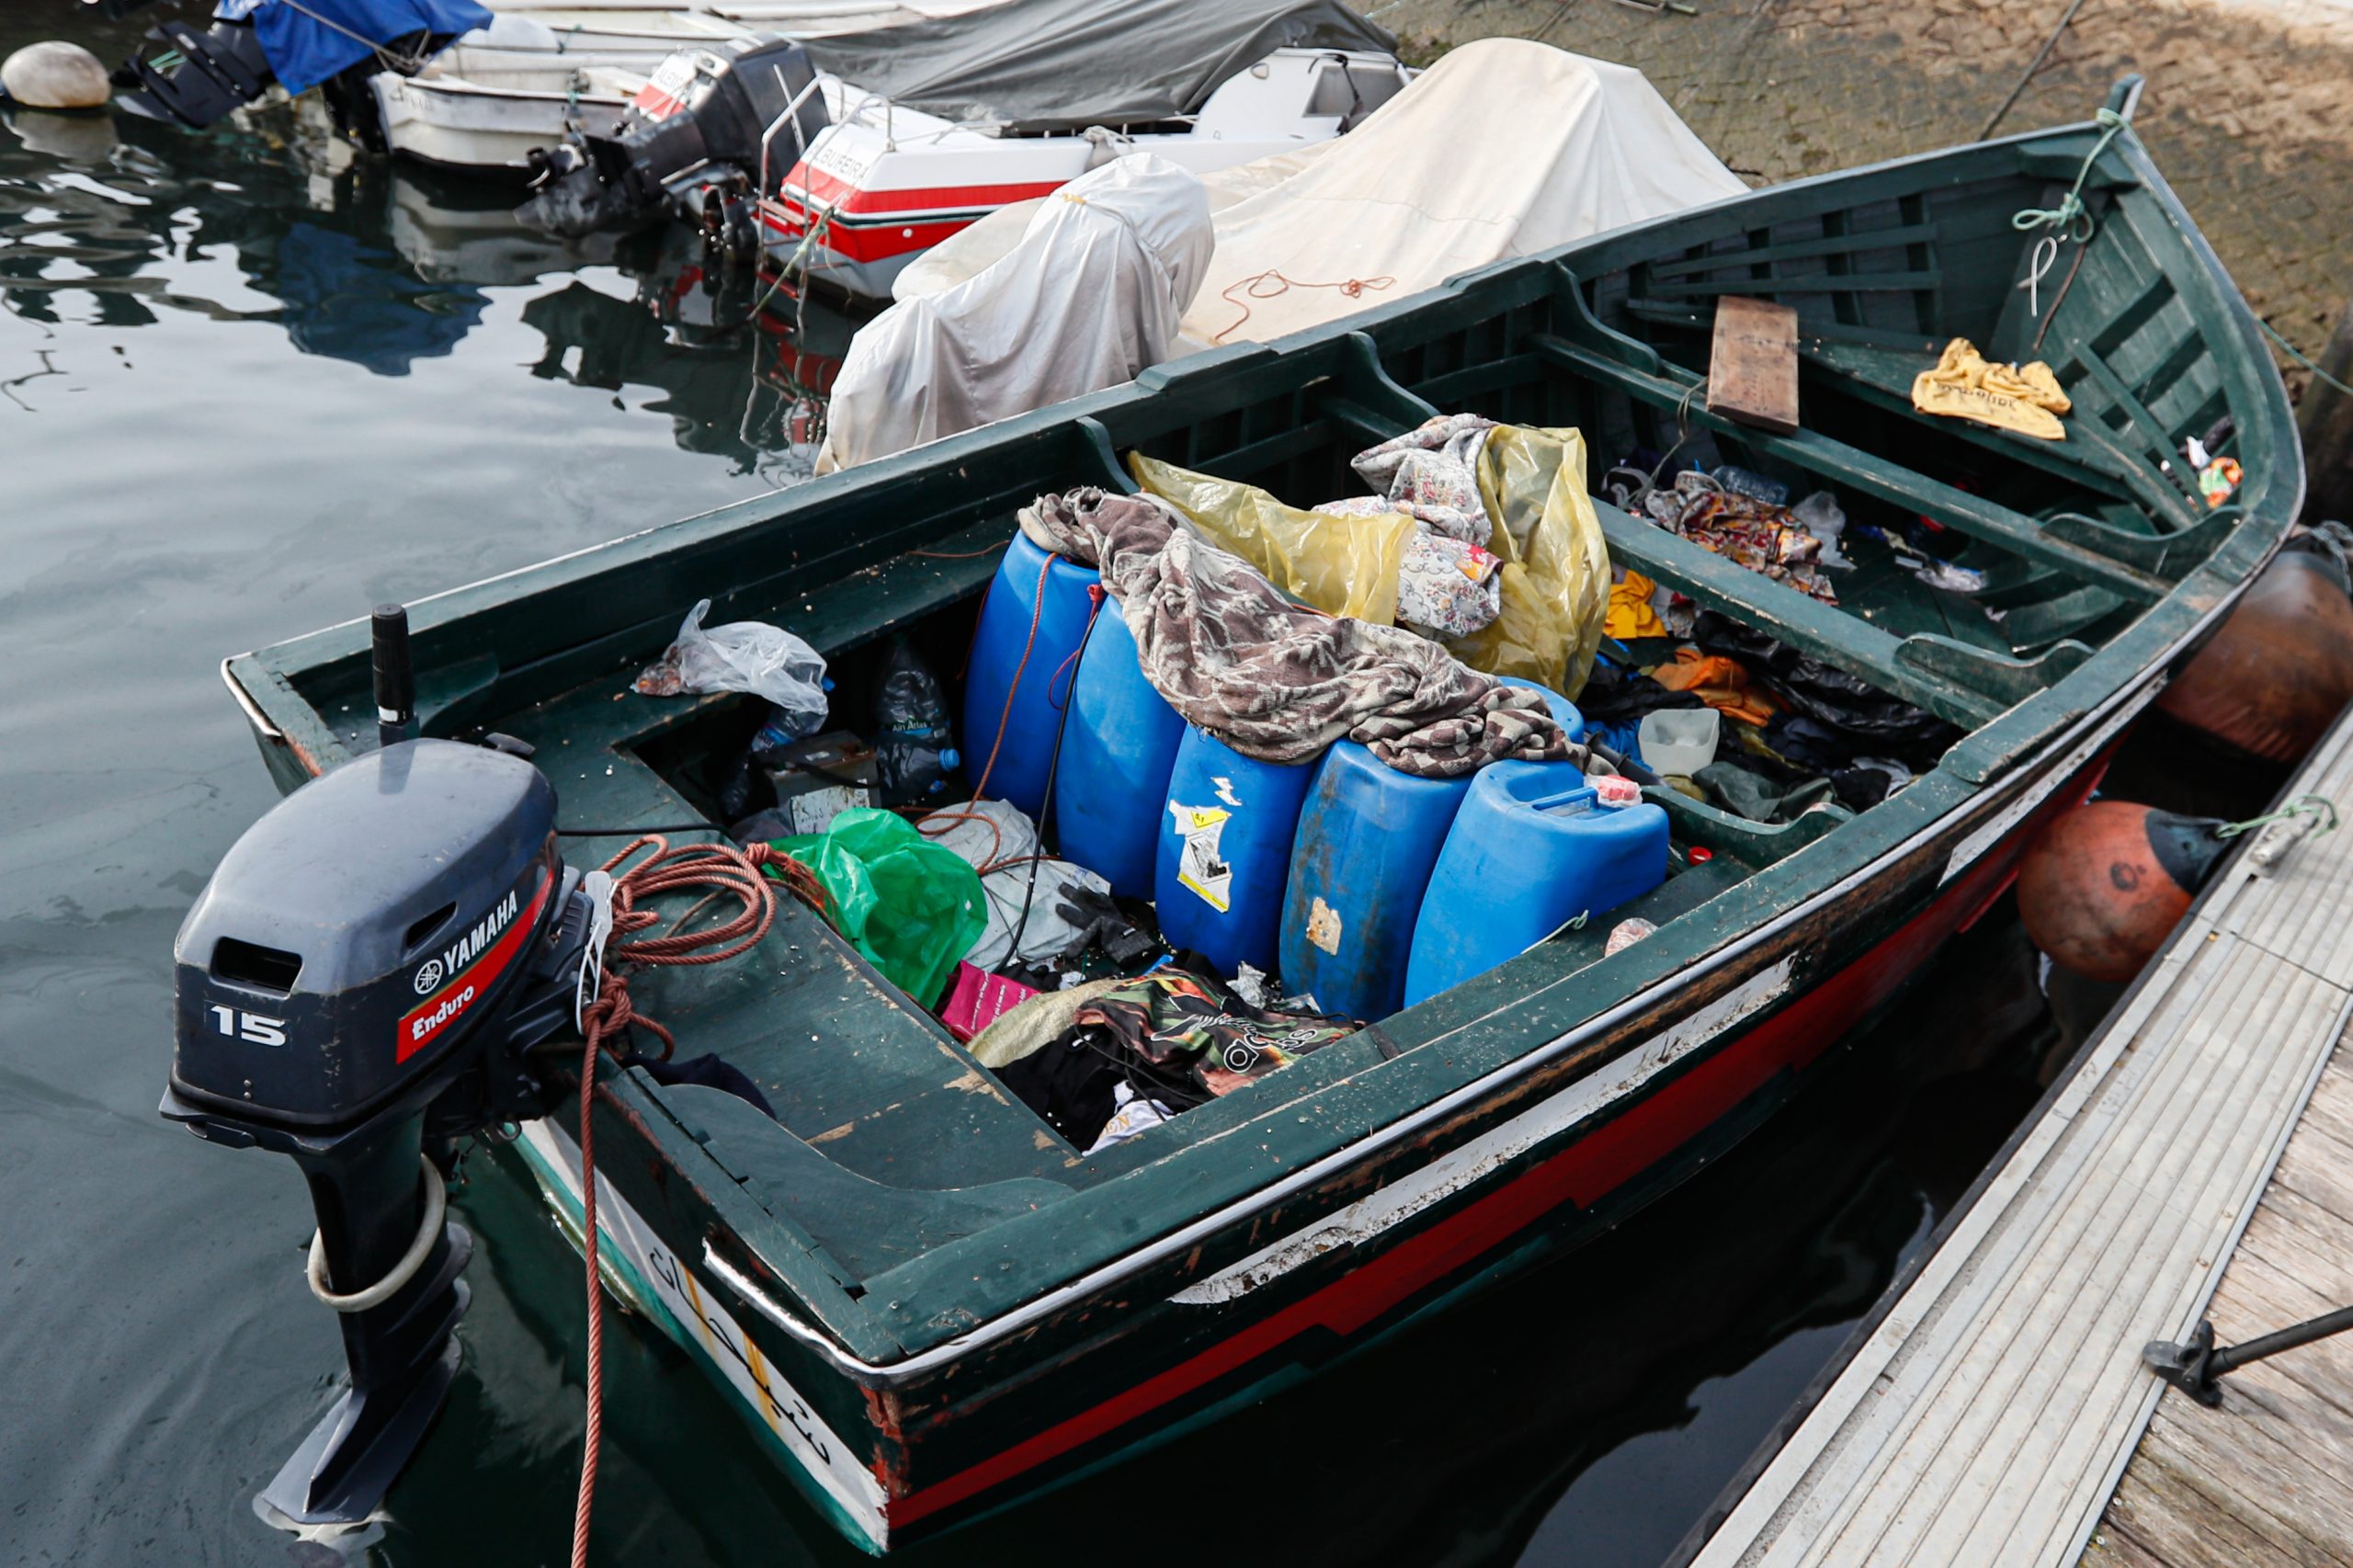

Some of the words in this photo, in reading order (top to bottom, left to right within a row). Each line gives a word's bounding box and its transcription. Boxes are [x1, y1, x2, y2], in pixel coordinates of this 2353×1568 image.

[443, 889, 518, 975] YAMAHA
[210, 1005, 286, 1047] 15
[412, 985, 474, 1040] Enduro
